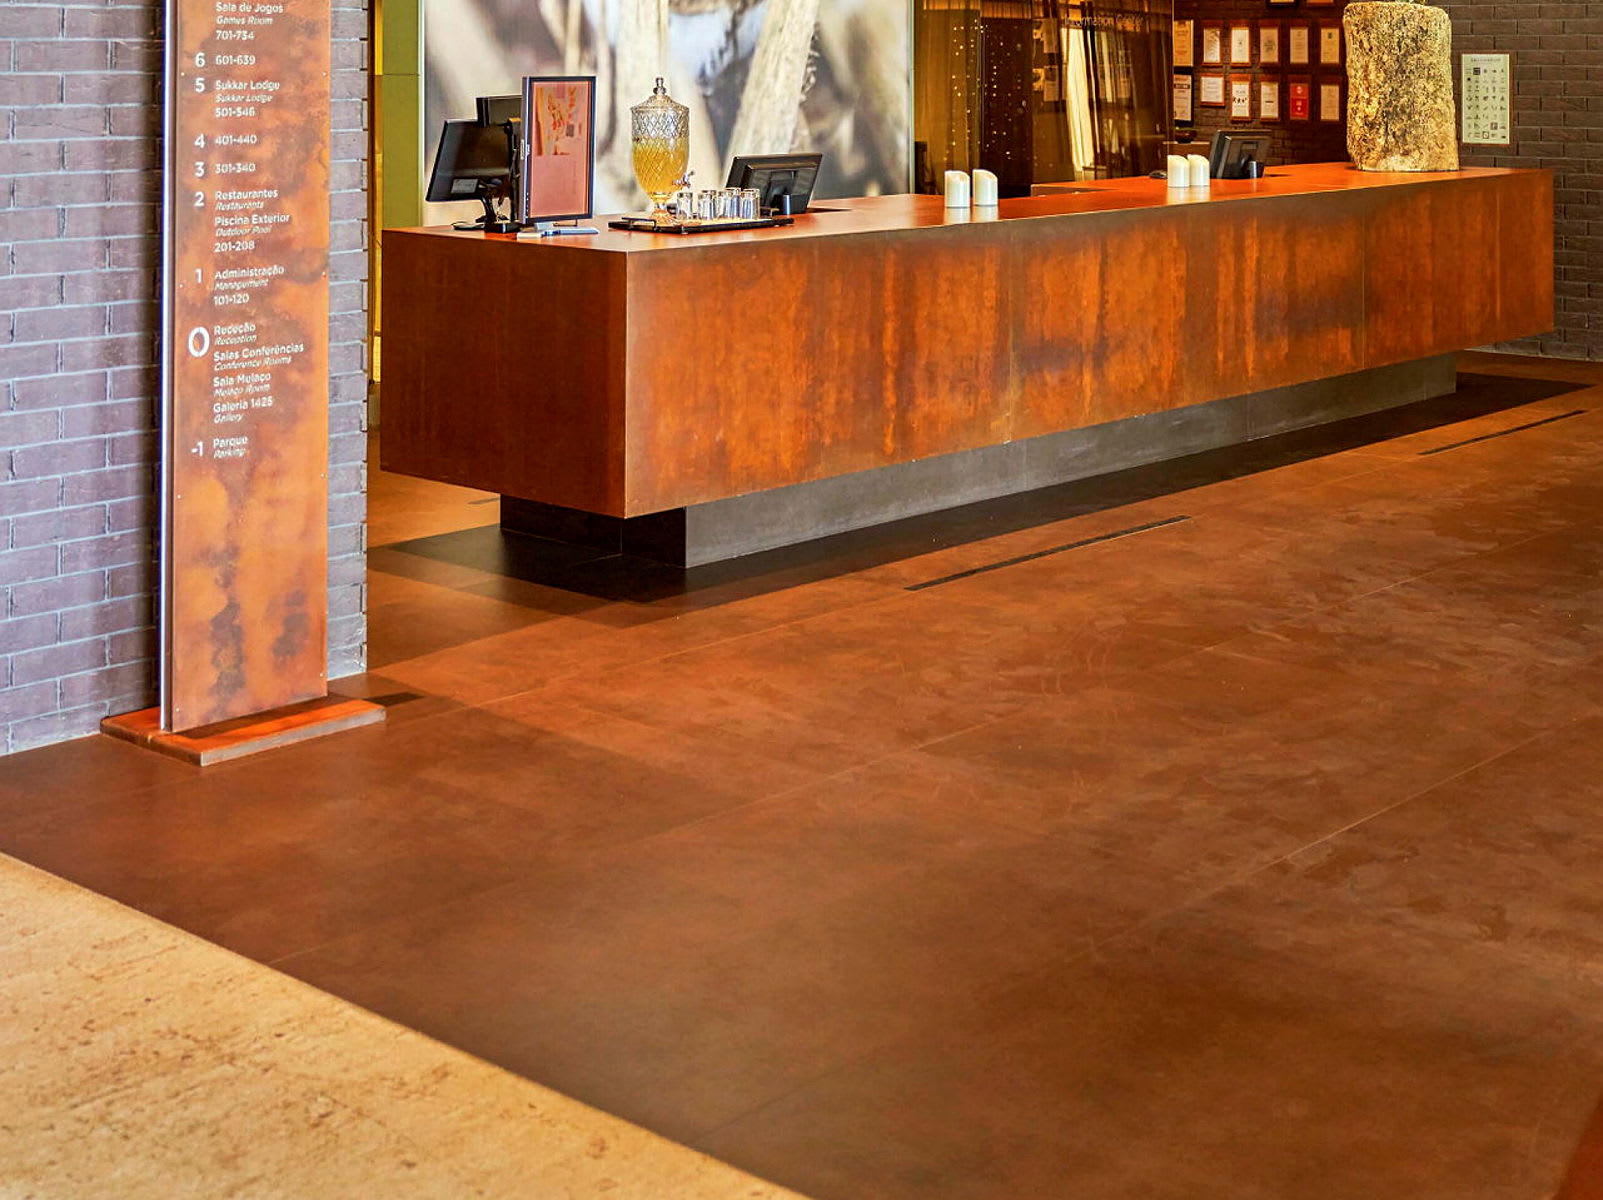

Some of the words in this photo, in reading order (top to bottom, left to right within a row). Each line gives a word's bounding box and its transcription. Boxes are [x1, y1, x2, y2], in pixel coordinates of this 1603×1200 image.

[216, 3, 237, 12] Sala
[239, 3, 251, 12] de
[254, 3, 284, 15] Jogos
[216, 31, 255, 40] 701-734
[195, 52, 206, 67] 6
[216, 55, 255, 65] 601-639
[195, 78, 205, 92] 5
[216, 81, 247, 90] Sukkar
[250, 81, 279, 91] Lodge
[216, 94, 245, 102] Sukkar
[246, 94, 272, 103] Lodge
[215, 108, 255, 117] 501-546
[195, 134, 205, 148] 4
[215, 135, 257, 145] 401-440
[195, 162, 205, 177] 3
[215, 164, 256, 173] 301-340
[194, 192, 205, 207] 2
[215, 189, 278, 200] Restaurantes
[214, 216, 249, 226] Piscina
[252, 214, 290, 224] Exterior
[214, 242, 255, 253] 201-208
[195, 270, 202, 283] 1
[214, 266, 284, 280] Administração
[214, 294, 249, 306] 101-120
[188, 327, 209, 357] 0
[213, 351, 239, 361] Salas
[213, 376, 234, 386] Sala
[213, 401, 248, 413] Galeria
[214, 413, 243, 423] Gallery
[213, 437, 248, 448] Parque
[192, 442, 204, 456] -1
